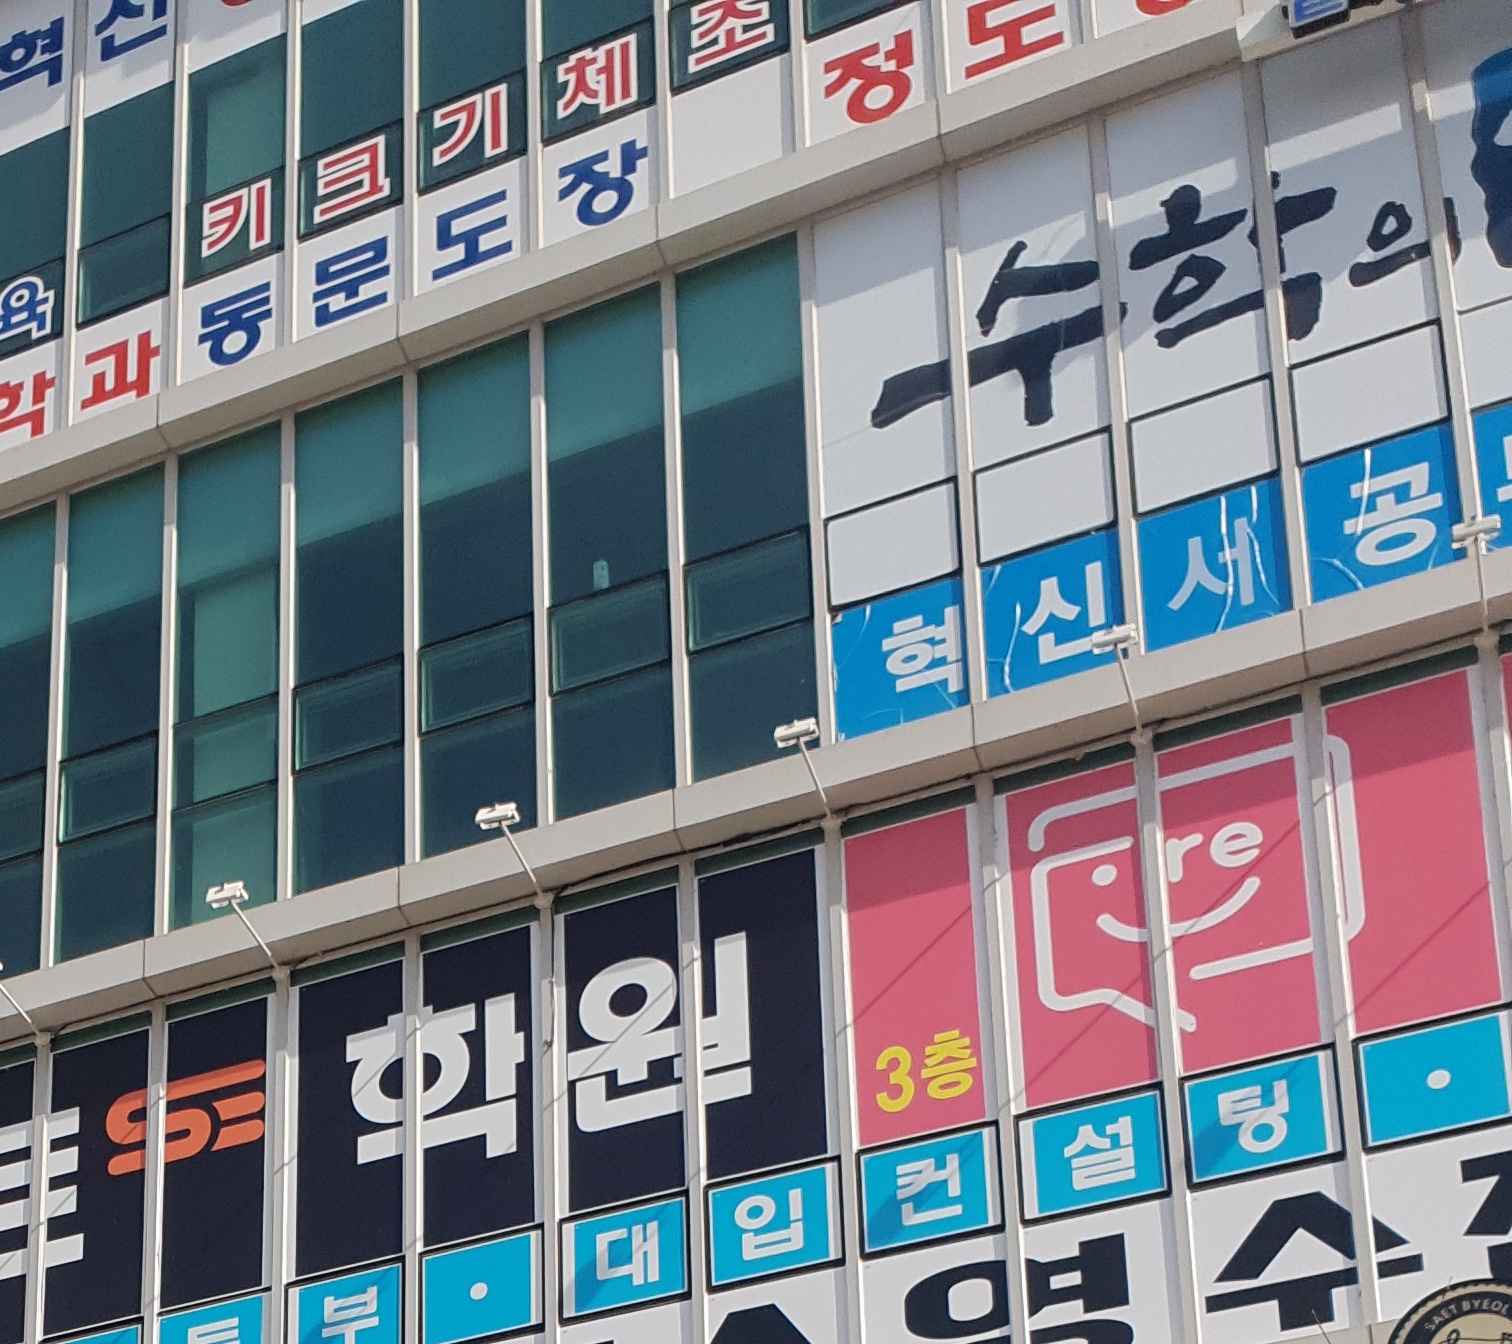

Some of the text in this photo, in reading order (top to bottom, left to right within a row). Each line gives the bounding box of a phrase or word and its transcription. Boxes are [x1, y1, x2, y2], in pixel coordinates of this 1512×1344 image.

[198, 139, 649, 367] 동문도장
[345, 930, 755, 1165] 학원
[875, 1029, 978, 1113] 3층
